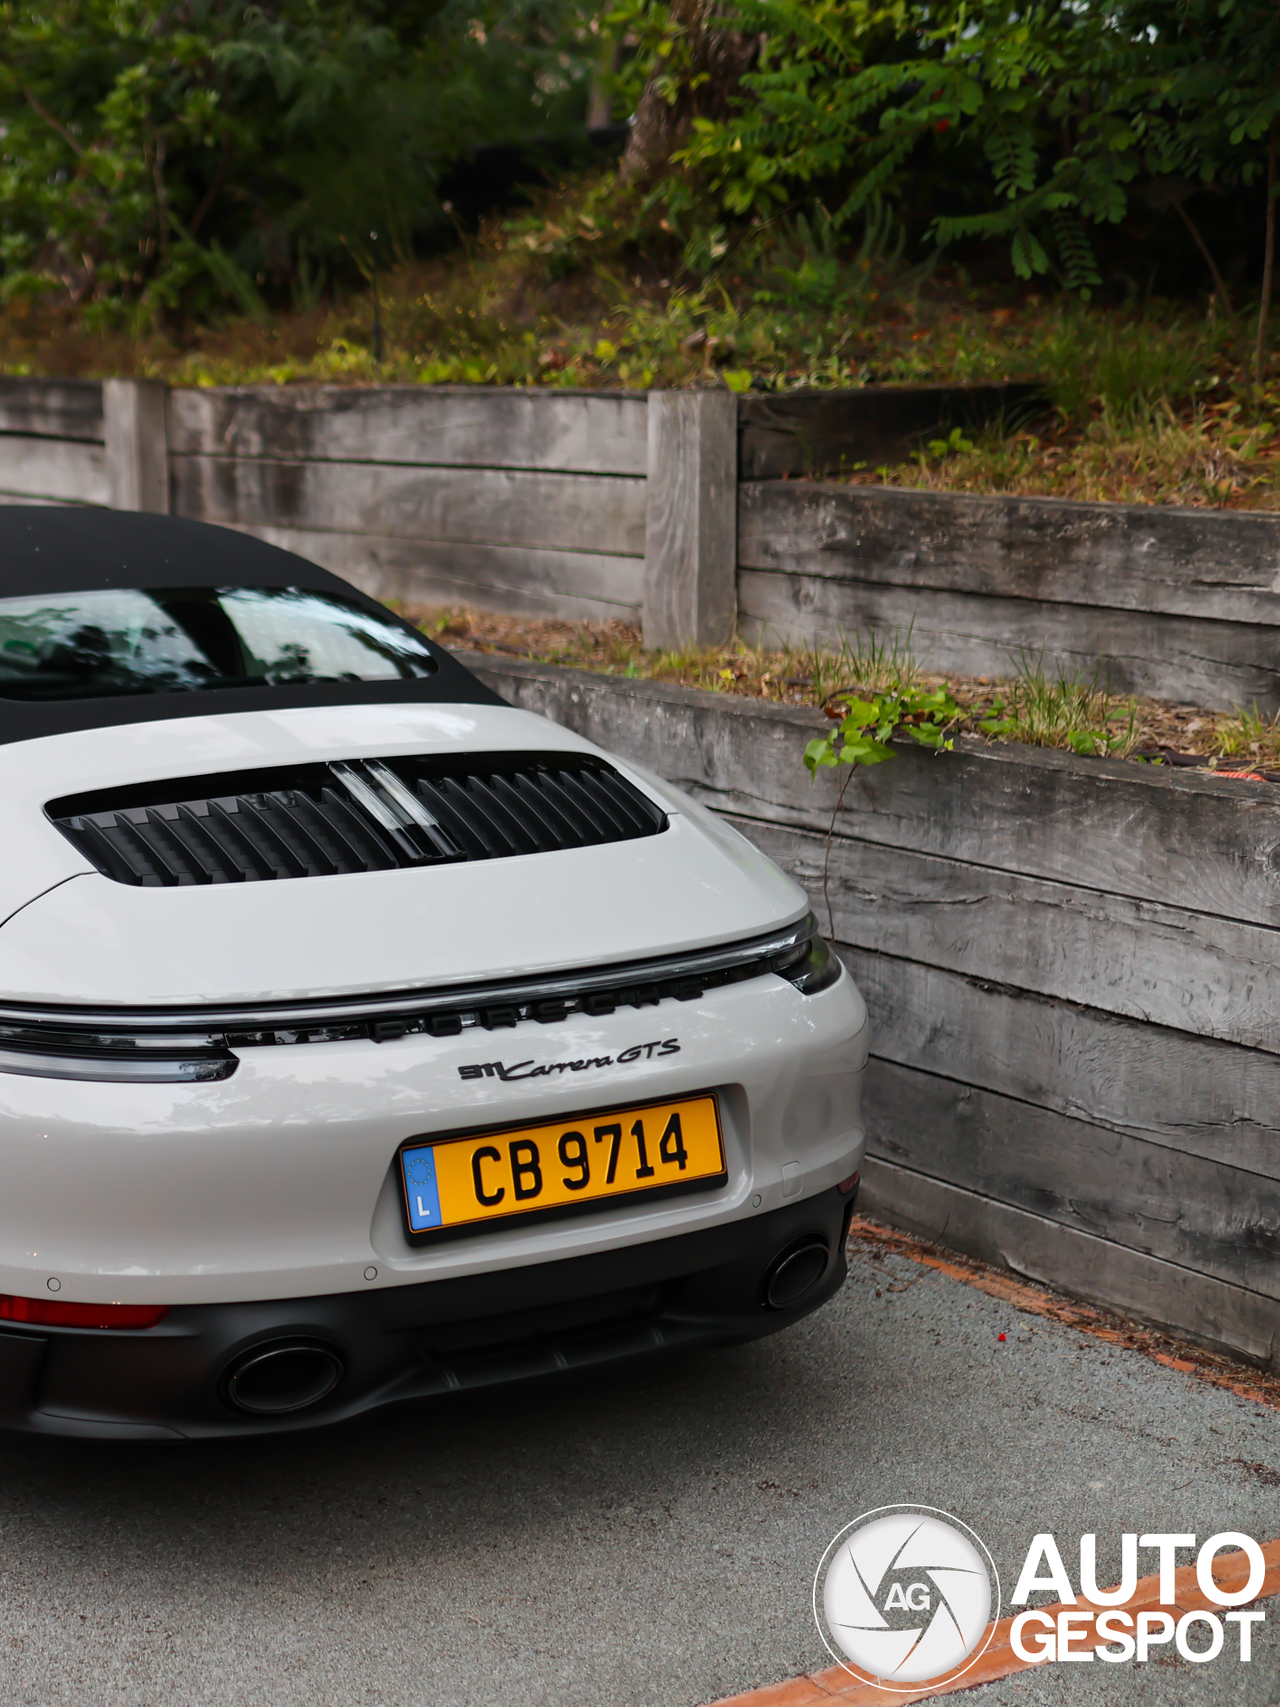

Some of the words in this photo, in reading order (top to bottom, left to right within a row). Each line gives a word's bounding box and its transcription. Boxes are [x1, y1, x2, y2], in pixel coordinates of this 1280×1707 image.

[373, 977, 703, 1043] PORSCHE
[458, 1062, 505, 1080] 911
[500, 1057, 614, 1081] Carrera
[616, 1038, 682, 1063] GTS
[471, 1139, 543, 1207] CB
[558, 1113, 688, 1191] 9714
[416, 1196, 430, 1217] L
